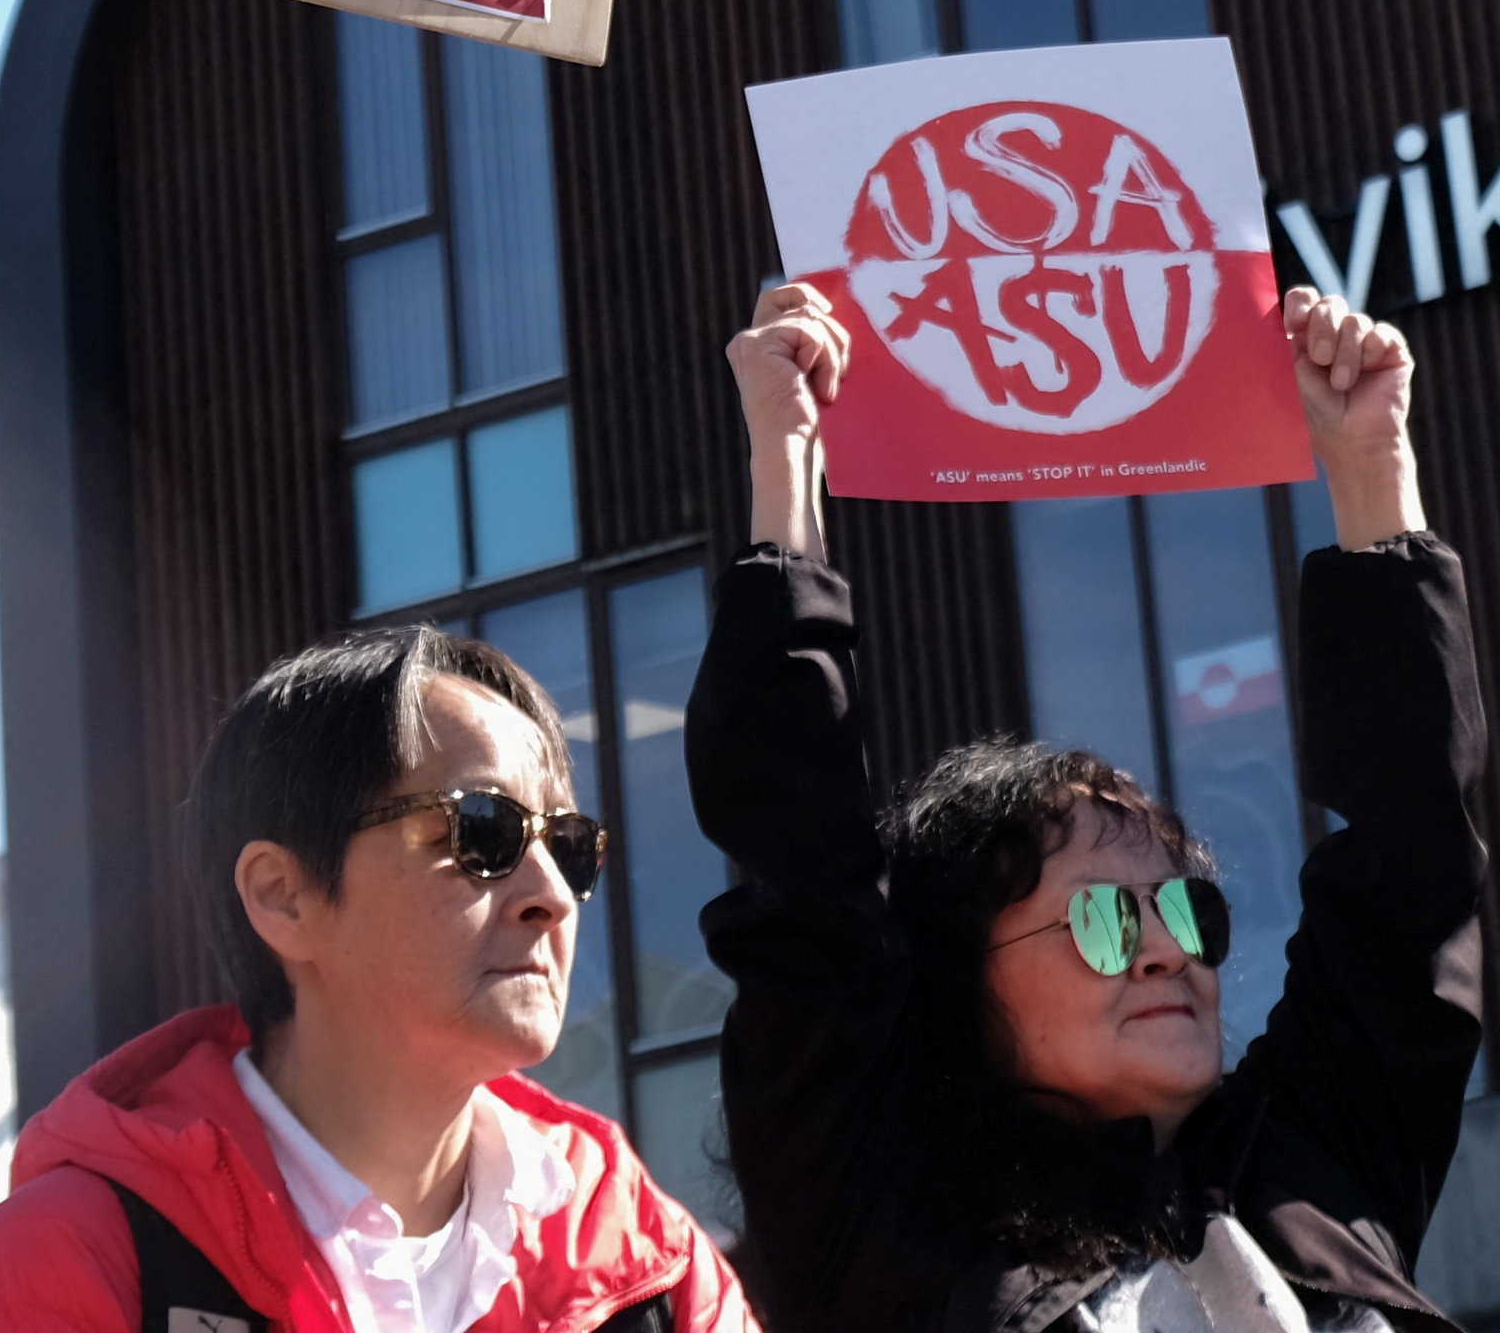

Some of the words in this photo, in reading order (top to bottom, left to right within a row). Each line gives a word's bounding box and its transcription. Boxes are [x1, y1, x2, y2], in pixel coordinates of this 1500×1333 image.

[869, 112, 1195, 259] USA
[882, 260, 1191, 418] ASU
[976, 470, 1023, 482] means
[1100, 464, 1114, 477] in
[1118, 459, 1208, 477] Greenlandic
